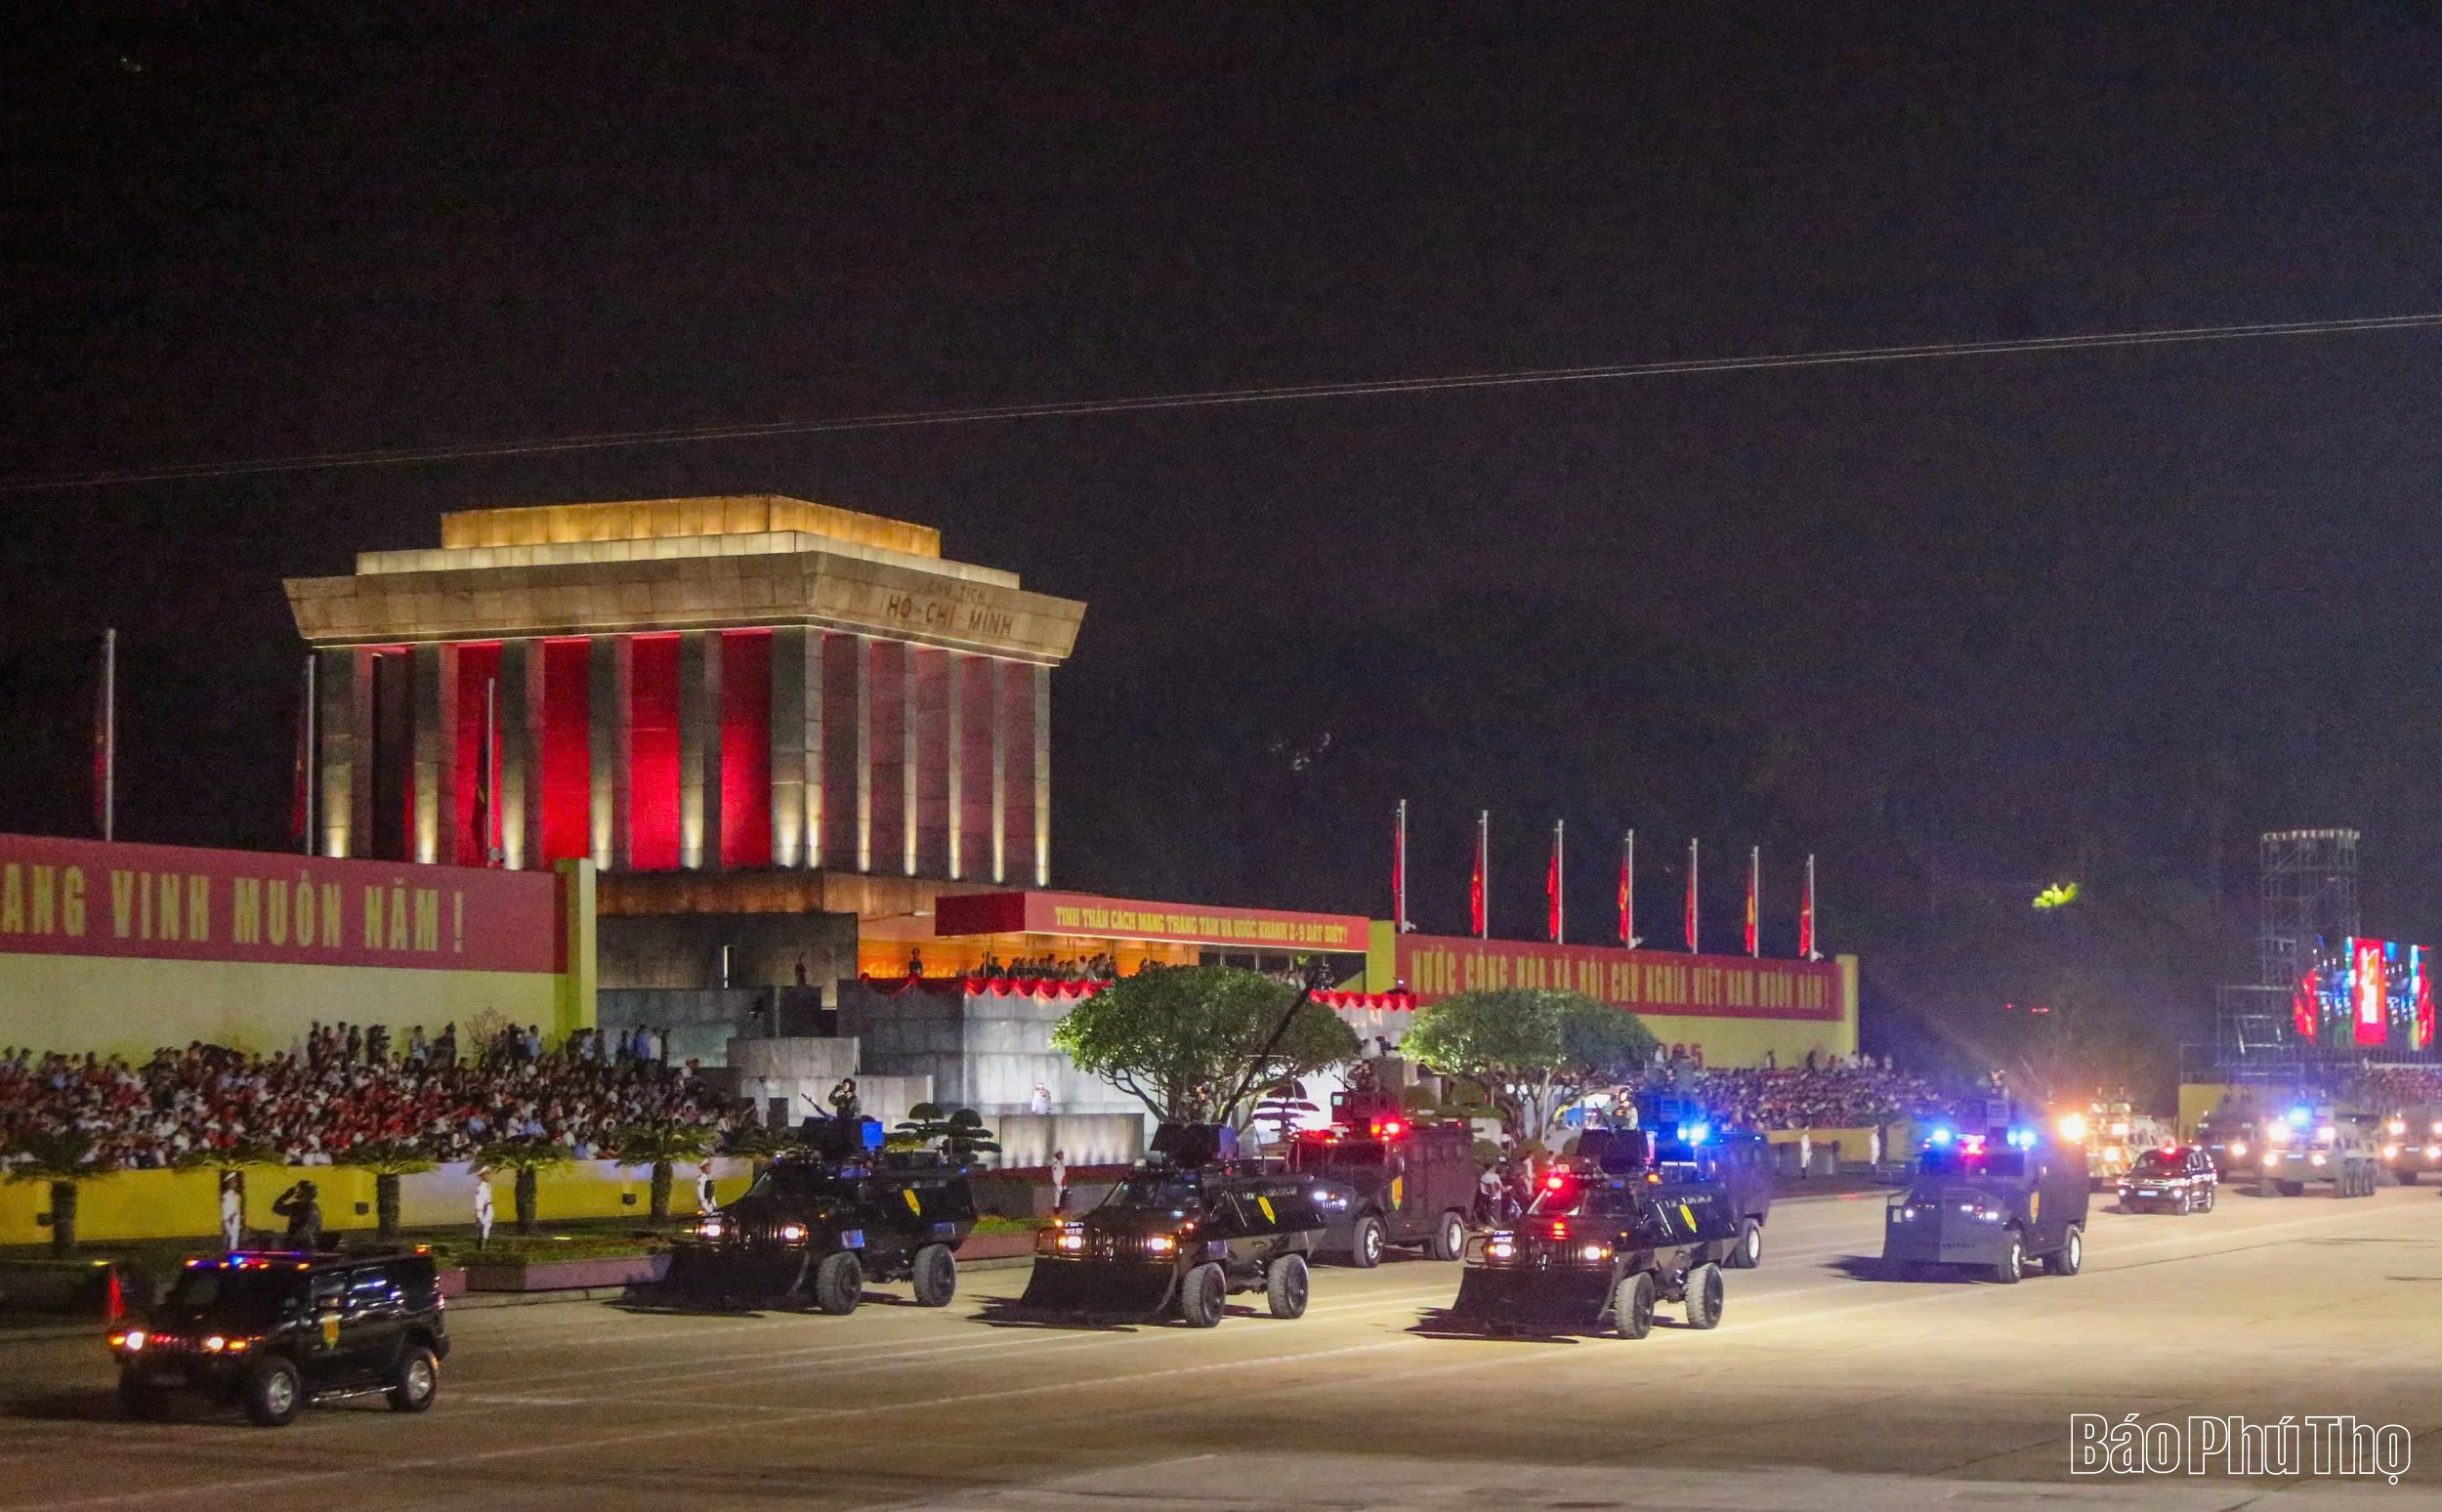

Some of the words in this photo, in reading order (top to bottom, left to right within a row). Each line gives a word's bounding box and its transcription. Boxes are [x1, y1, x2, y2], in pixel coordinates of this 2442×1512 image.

[110, 868, 209, 943] VINH
[233, 869, 341, 947] MUÔN
[1055, 905, 1079, 927] TINH
[1082, 903, 1109, 929] THẦN
[1111, 906, 1136, 931] CÁCH
[1138, 911, 1164, 934] MẠNG
[1166, 912, 1198, 934] THÁNG
[1199, 915, 1220, 937] TÁM
[1412, 945, 1455, 994] NƯỚC
[1693, 962, 1721, 1008] VIỆT
[1727, 969, 1754, 1007] NAM
[1759, 967, 1793, 1008] MUÔN
